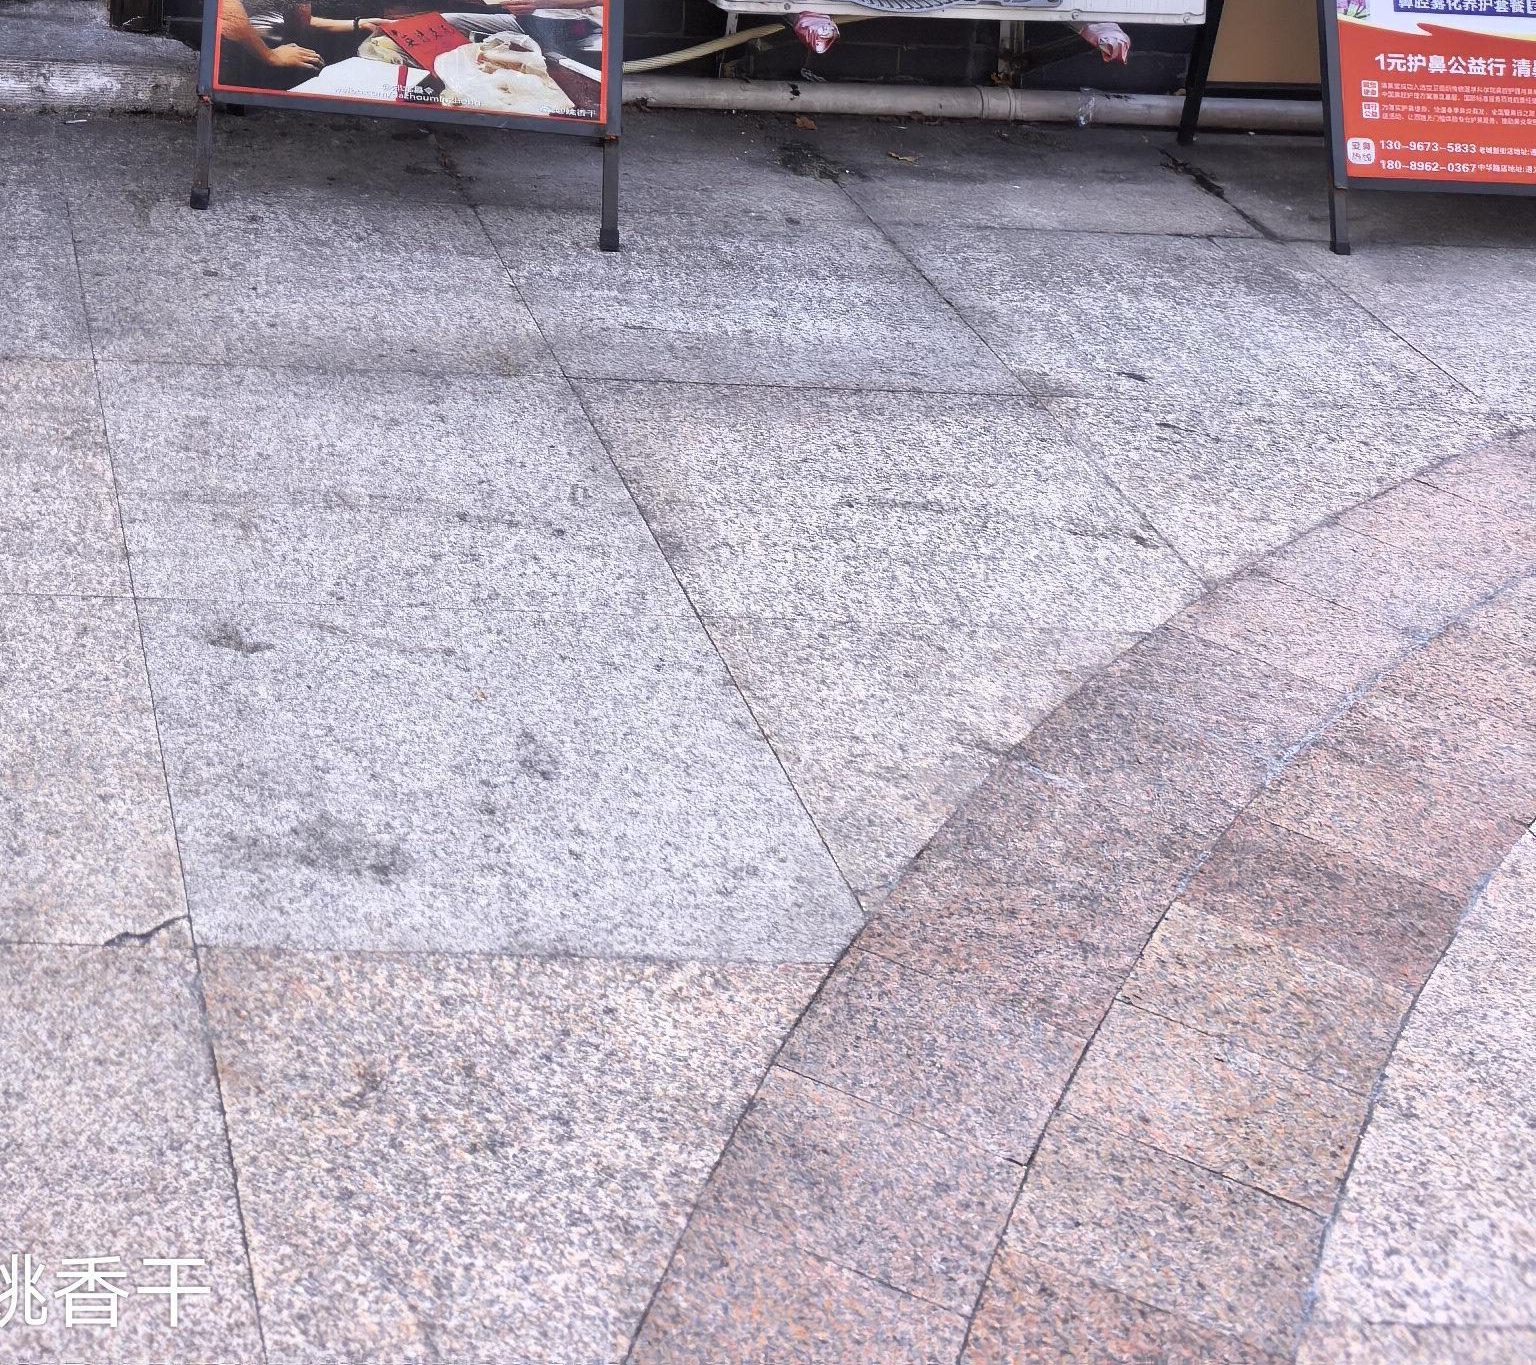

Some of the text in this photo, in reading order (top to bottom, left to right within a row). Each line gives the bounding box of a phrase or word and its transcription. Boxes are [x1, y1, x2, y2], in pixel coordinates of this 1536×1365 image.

[1375, 54, 1506, 77] 1元护鼻公益行
